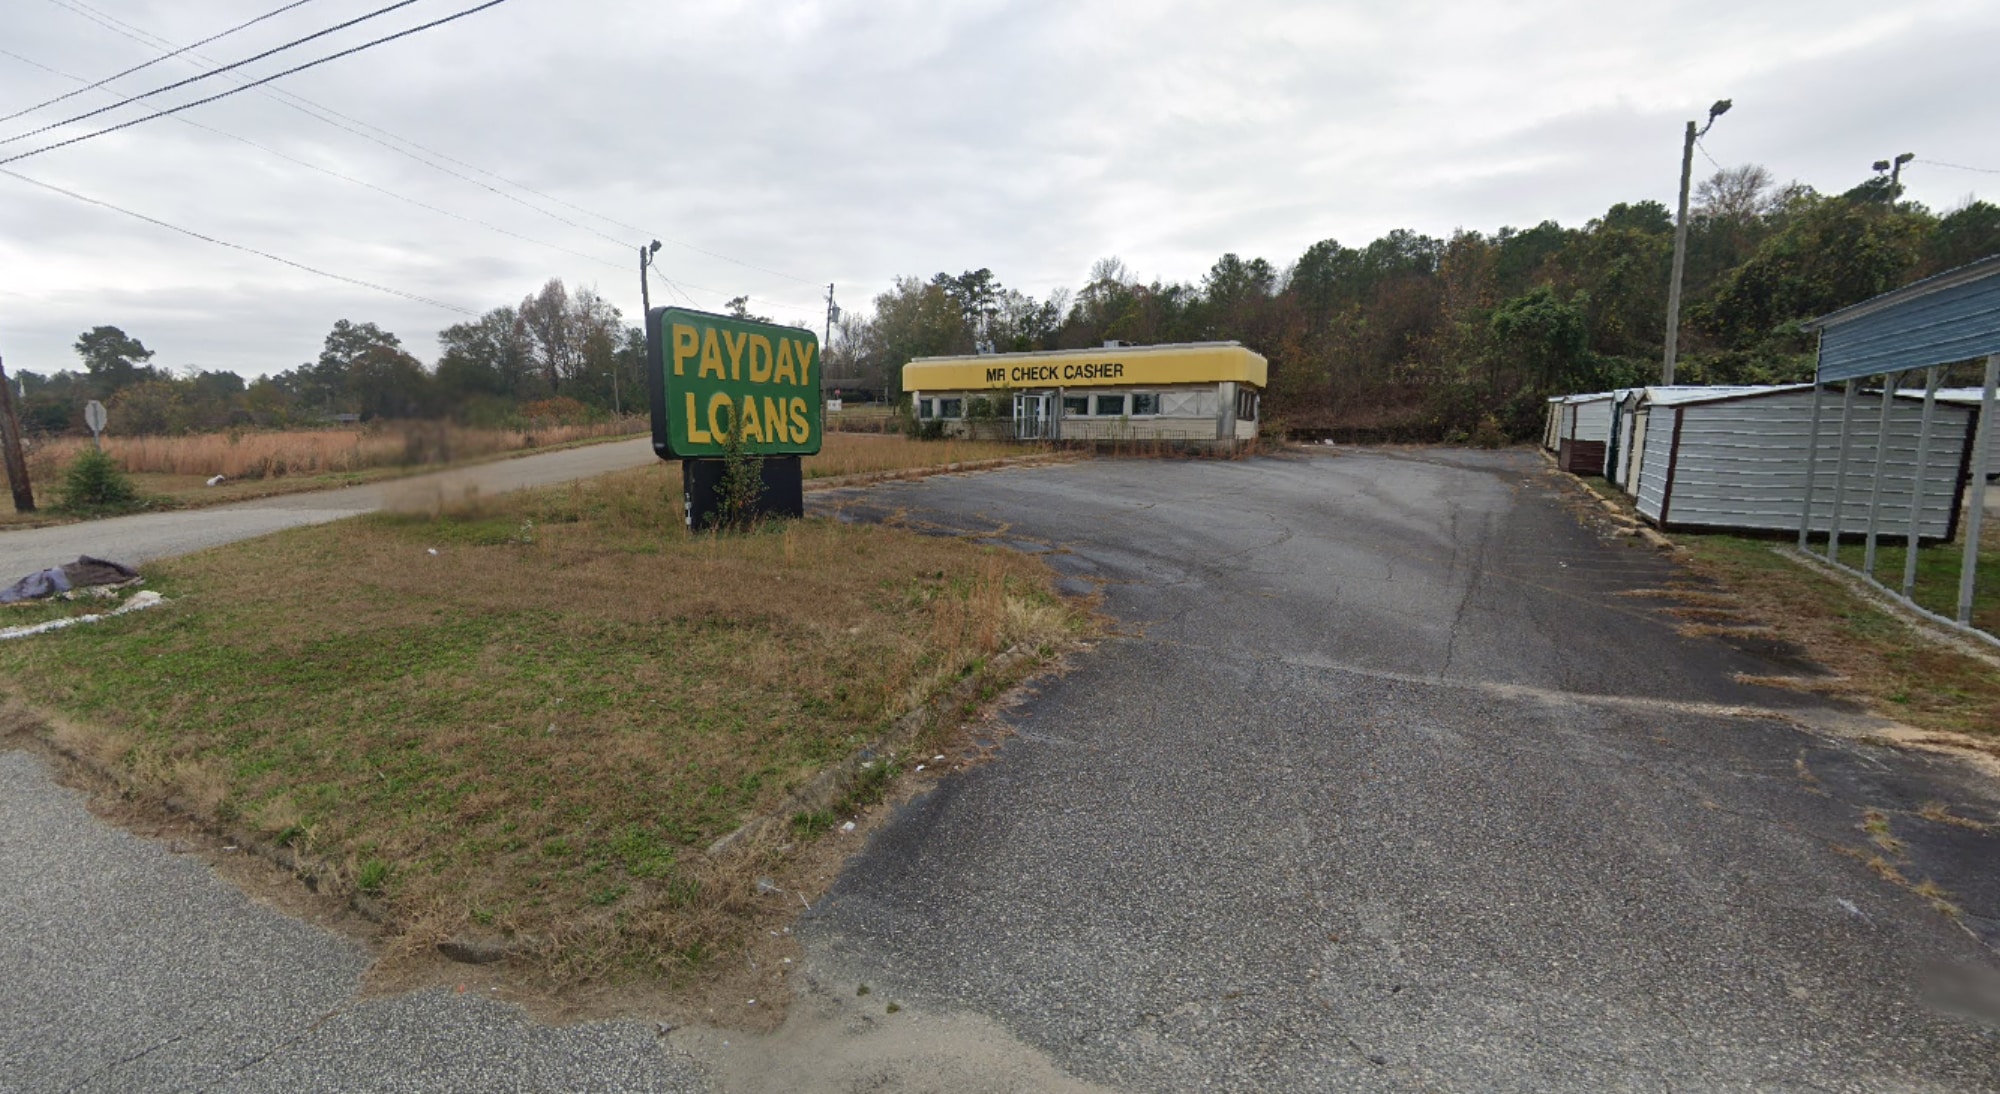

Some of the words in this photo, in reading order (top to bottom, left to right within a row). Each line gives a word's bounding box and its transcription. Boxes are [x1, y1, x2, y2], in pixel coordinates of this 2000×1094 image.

[673, 324, 814, 385] PAYDAY
[986, 367, 1006, 383] MR
[1012, 366, 1059, 381] CHECK
[1064, 363, 1124, 380] CASHER
[686, 392, 809, 444] LOANS
